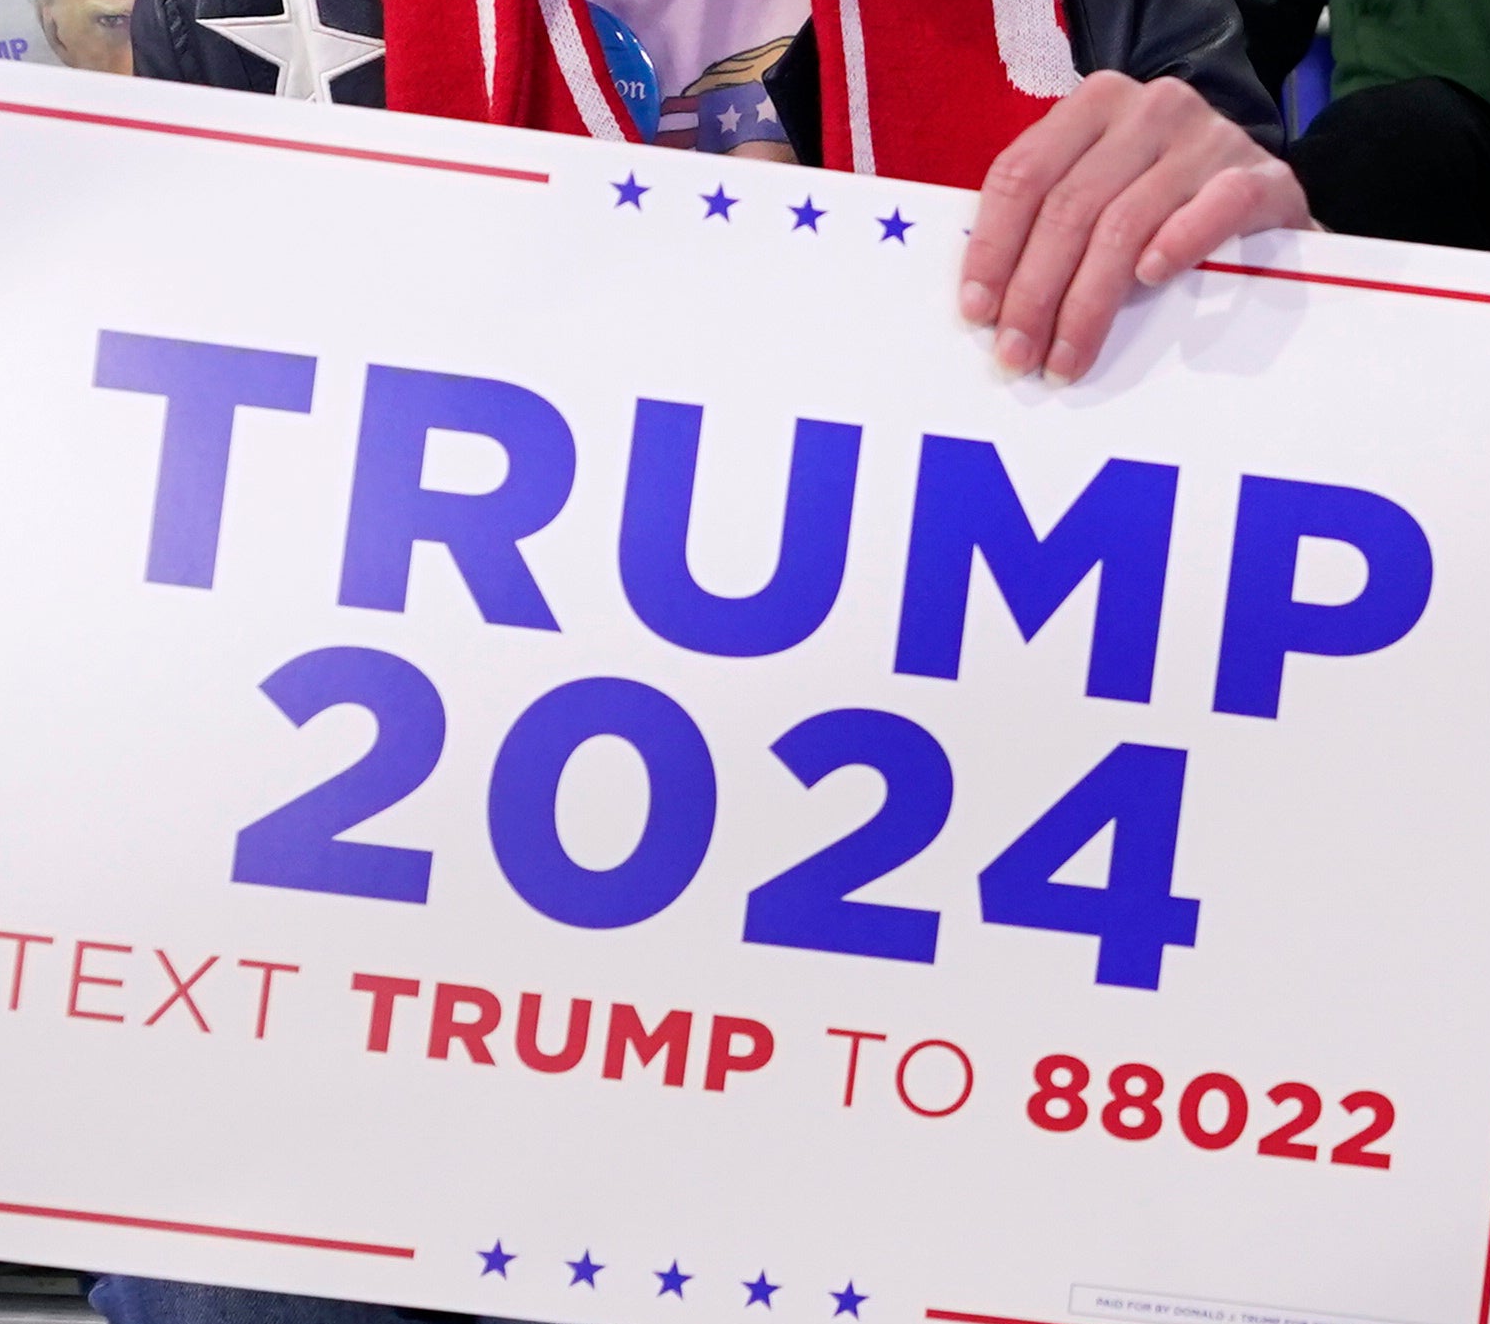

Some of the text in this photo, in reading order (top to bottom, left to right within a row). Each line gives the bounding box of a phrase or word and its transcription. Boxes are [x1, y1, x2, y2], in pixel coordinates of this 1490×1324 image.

[93, 330, 1435, 721] TRUMP
[230, 646, 1202, 992] 2024
[351, 972, 775, 1093] TRUMP
[826, 1027, 974, 1119] TO
[1026, 1053, 1396, 1171] 88022
